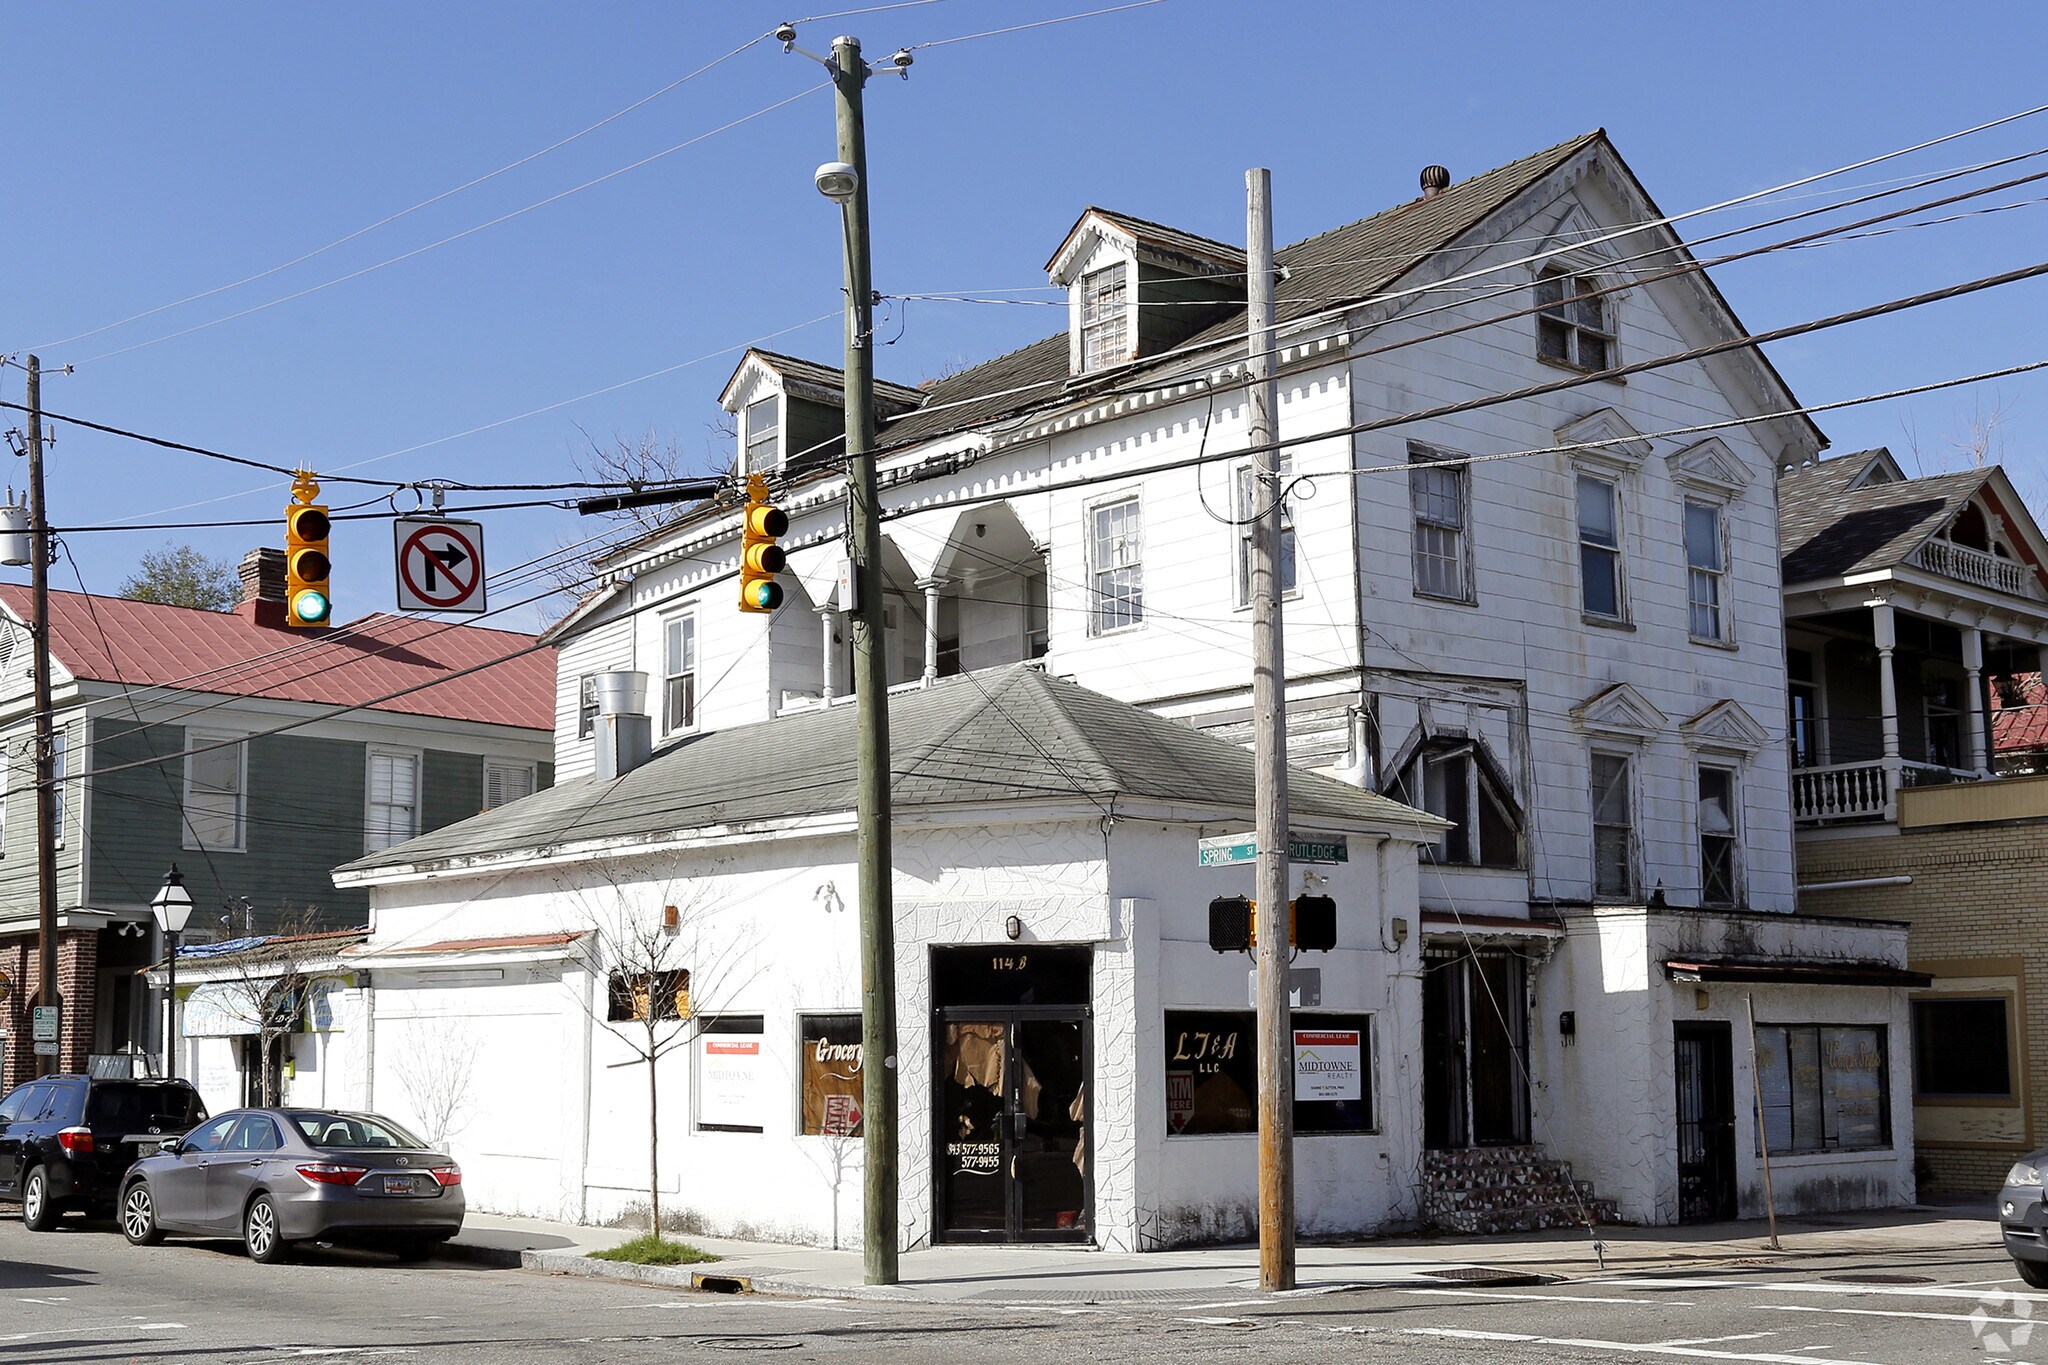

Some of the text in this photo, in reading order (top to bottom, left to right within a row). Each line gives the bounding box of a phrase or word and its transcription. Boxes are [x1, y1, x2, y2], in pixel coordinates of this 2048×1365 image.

[1203, 845, 1254, 864] SPRING ST
[1289, 843, 1335, 859] RUTLEDGE
[992, 955, 1028, 971] 114 B
[35, 1008, 41, 1018] 2
[815, 1036, 864, 1073] Grocery
[1199, 1062, 1220, 1074] LLC
[1299, 1061, 1353, 1071] MIDTOWNE
[1327, 1072, 1353, 1080] REALTY
